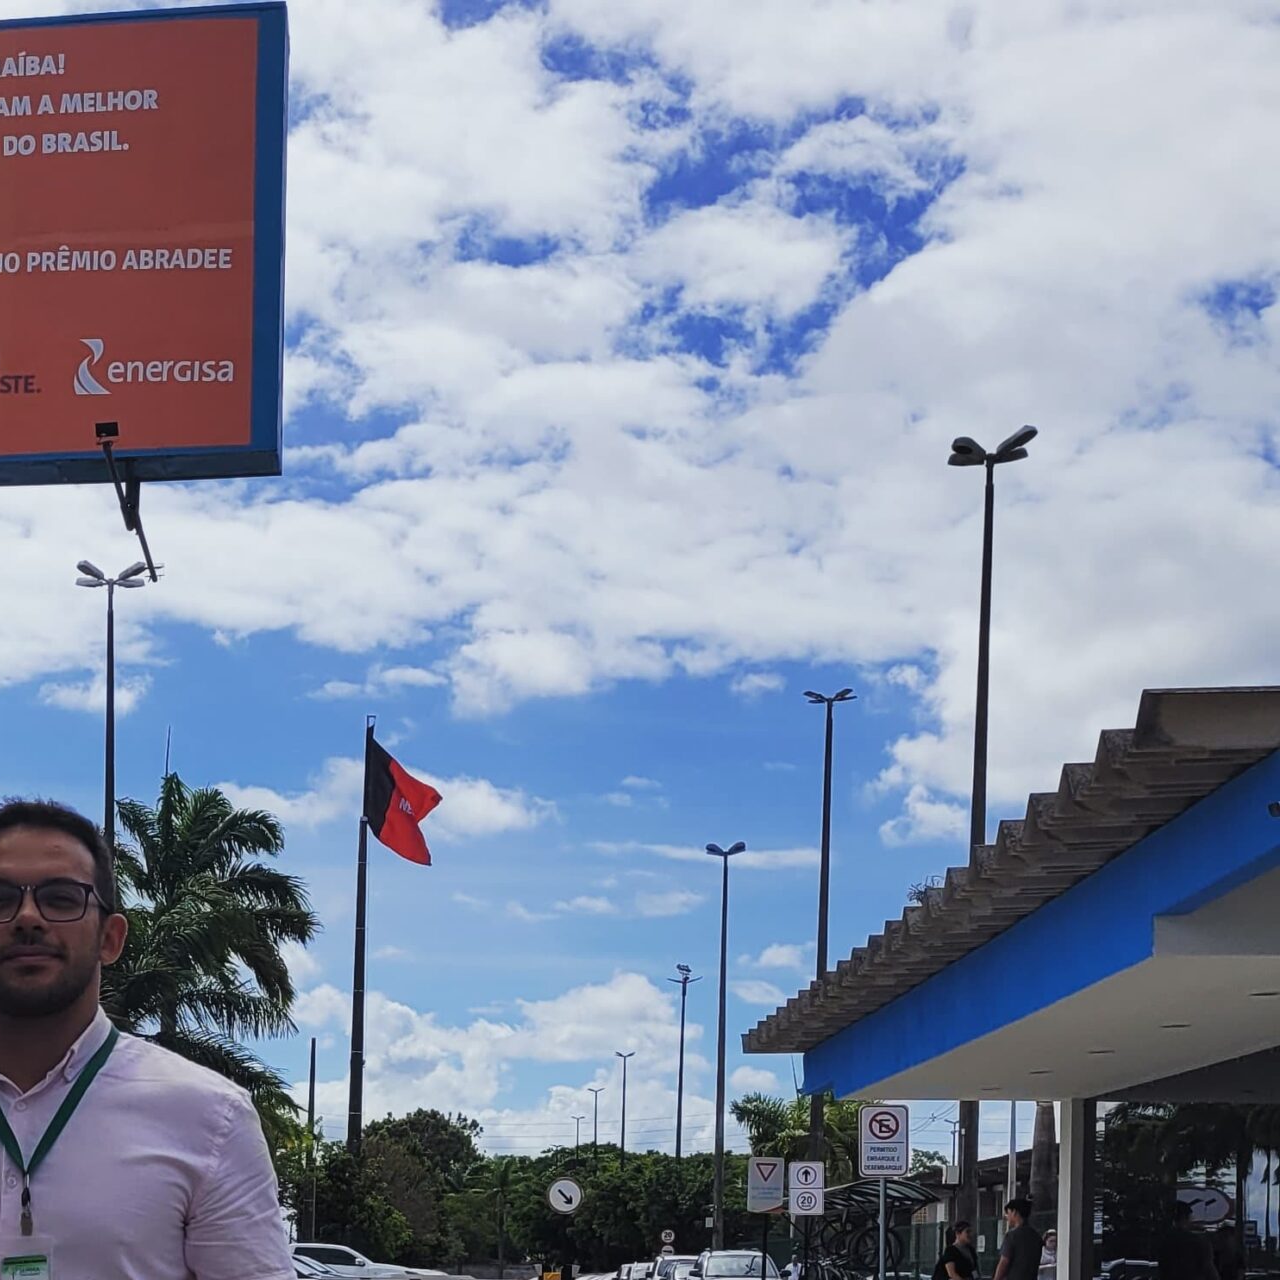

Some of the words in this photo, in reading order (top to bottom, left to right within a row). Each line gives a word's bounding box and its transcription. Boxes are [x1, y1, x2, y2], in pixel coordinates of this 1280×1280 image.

[37, 94, 53, 116] A
[59, 89, 159, 114] MELHOR
[3, 134, 36, 157] DO
[42, 130, 130, 154] BRASIL.
[26, 245, 116, 272] PRÊMIO
[122, 248, 232, 270] ABRADEE
[107, 358, 234, 383] energisa
[800, 1196, 813, 1205] 20
